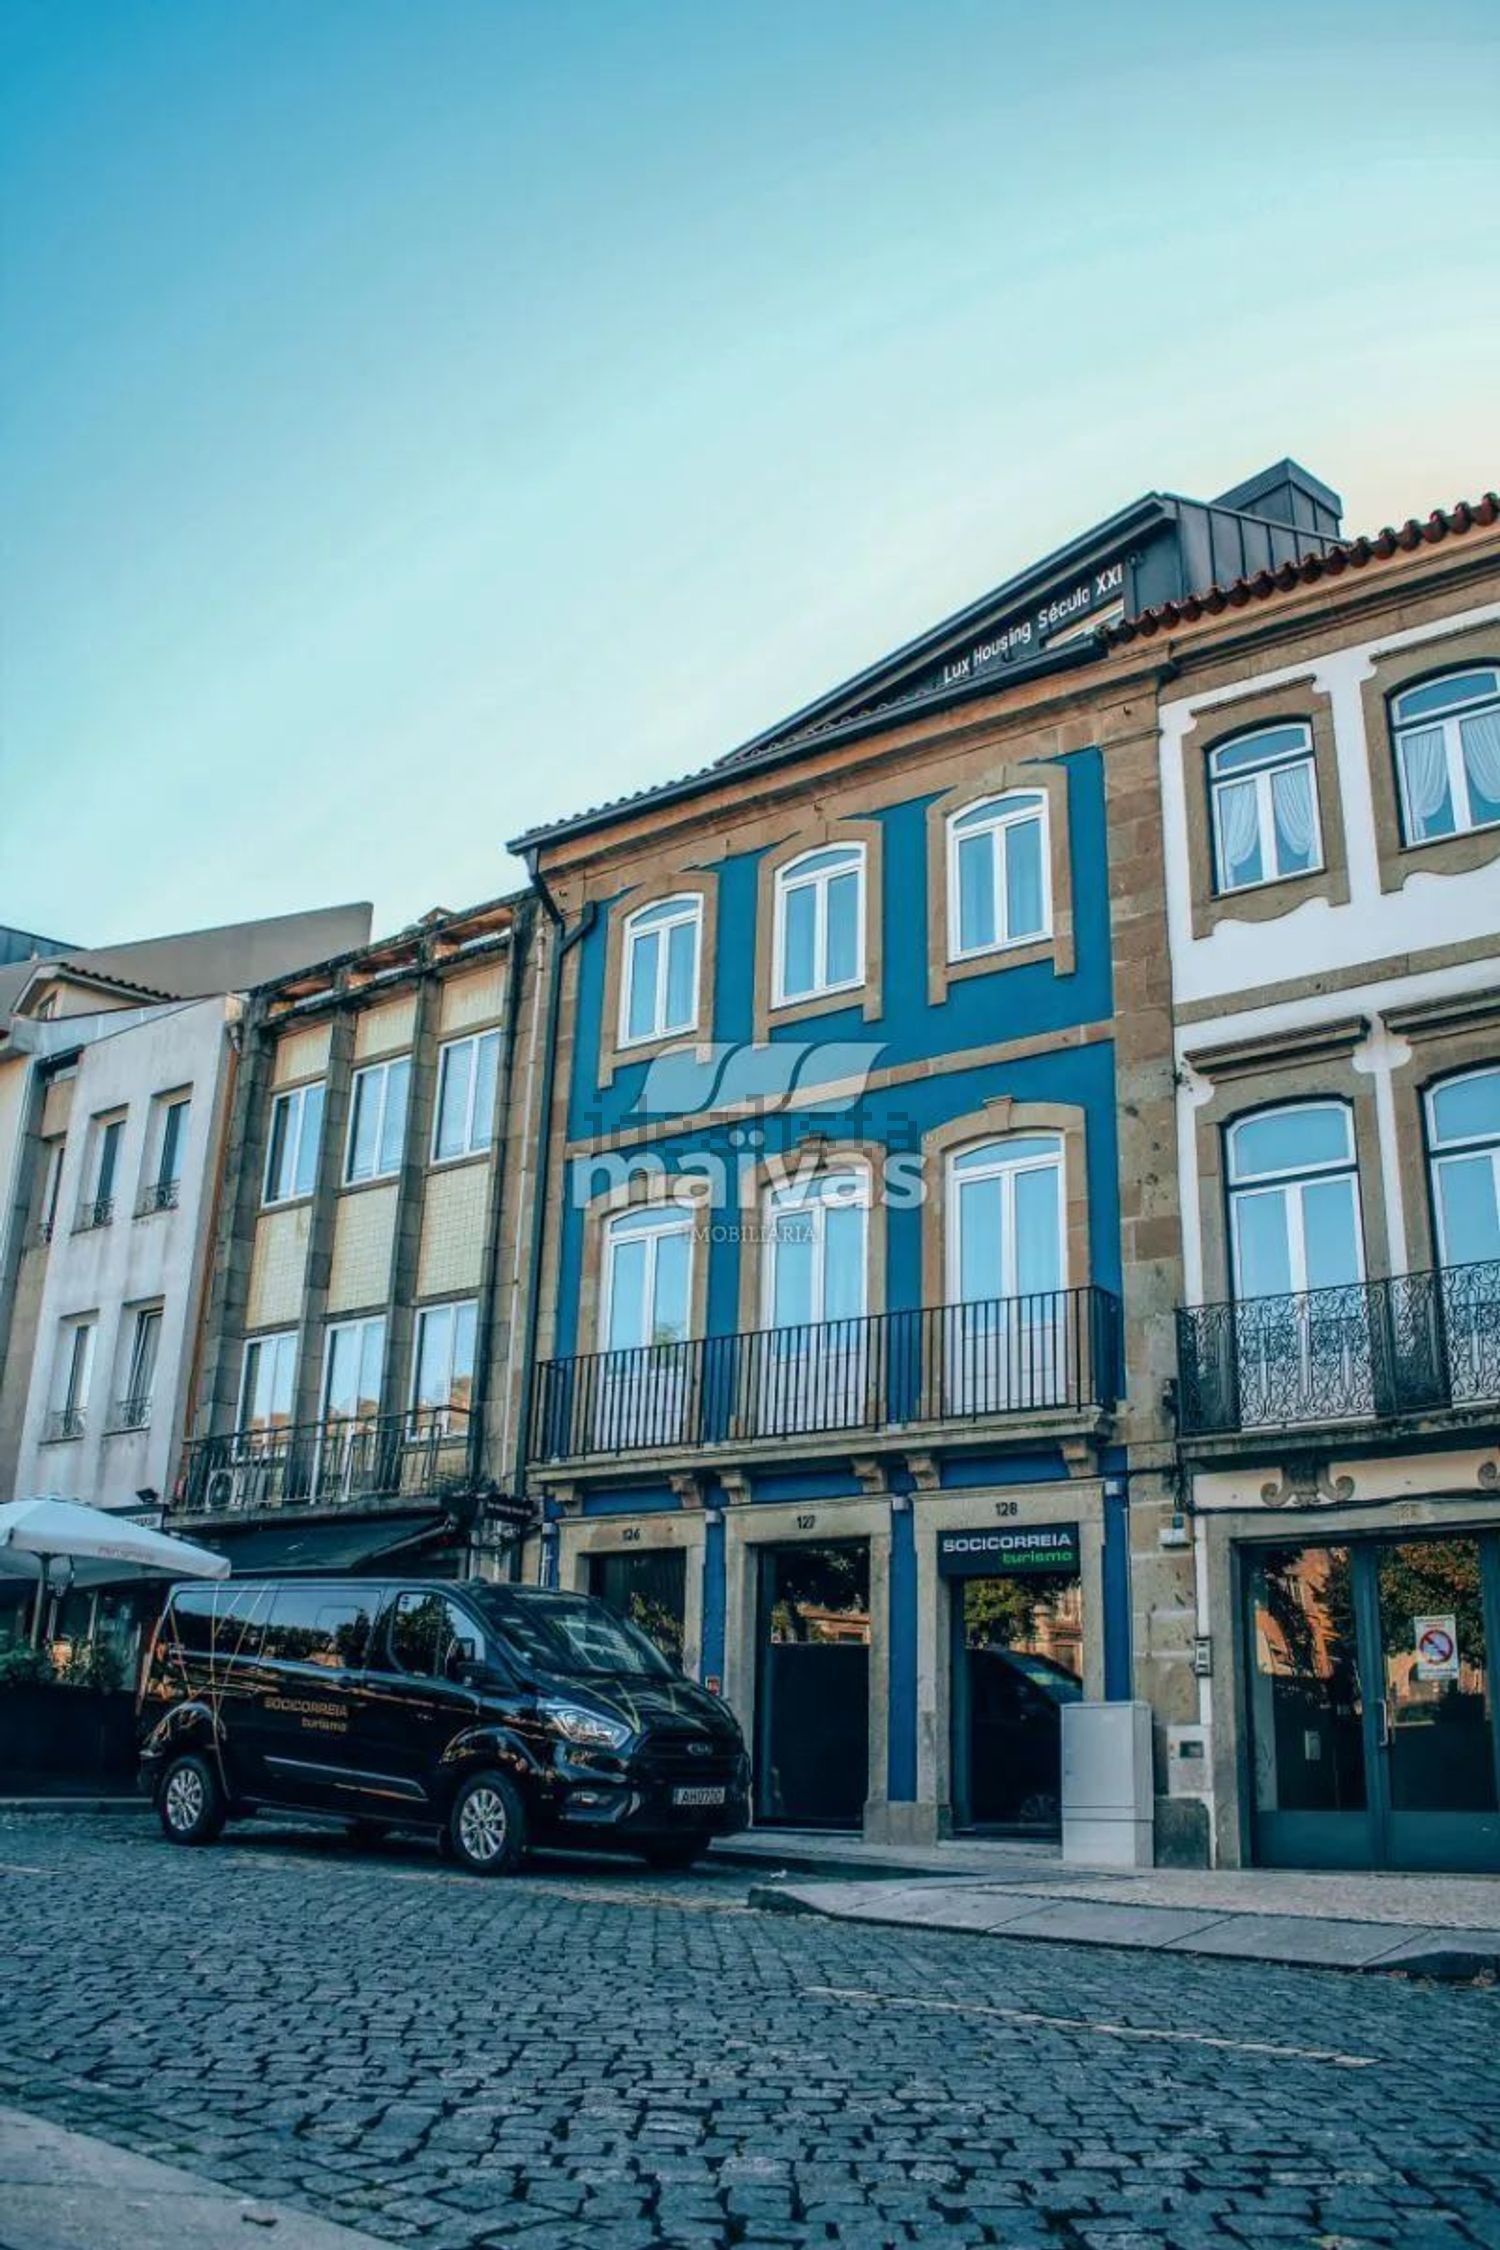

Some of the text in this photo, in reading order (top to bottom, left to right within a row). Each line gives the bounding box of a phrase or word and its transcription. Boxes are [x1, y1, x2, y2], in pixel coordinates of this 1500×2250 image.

[943, 655, 971, 683] Lux
[973, 621, 1031, 667] Housing
[1095, 563, 1123, 595] XXI
[995, 1502, 1018, 1516] 128
[796, 1514, 816, 1529] 127
[943, 1532, 1072, 1553] SOCICORREIA
[1002, 1549, 1073, 1564] turismo
[263, 1695, 349, 1719] SOCICORREIA
